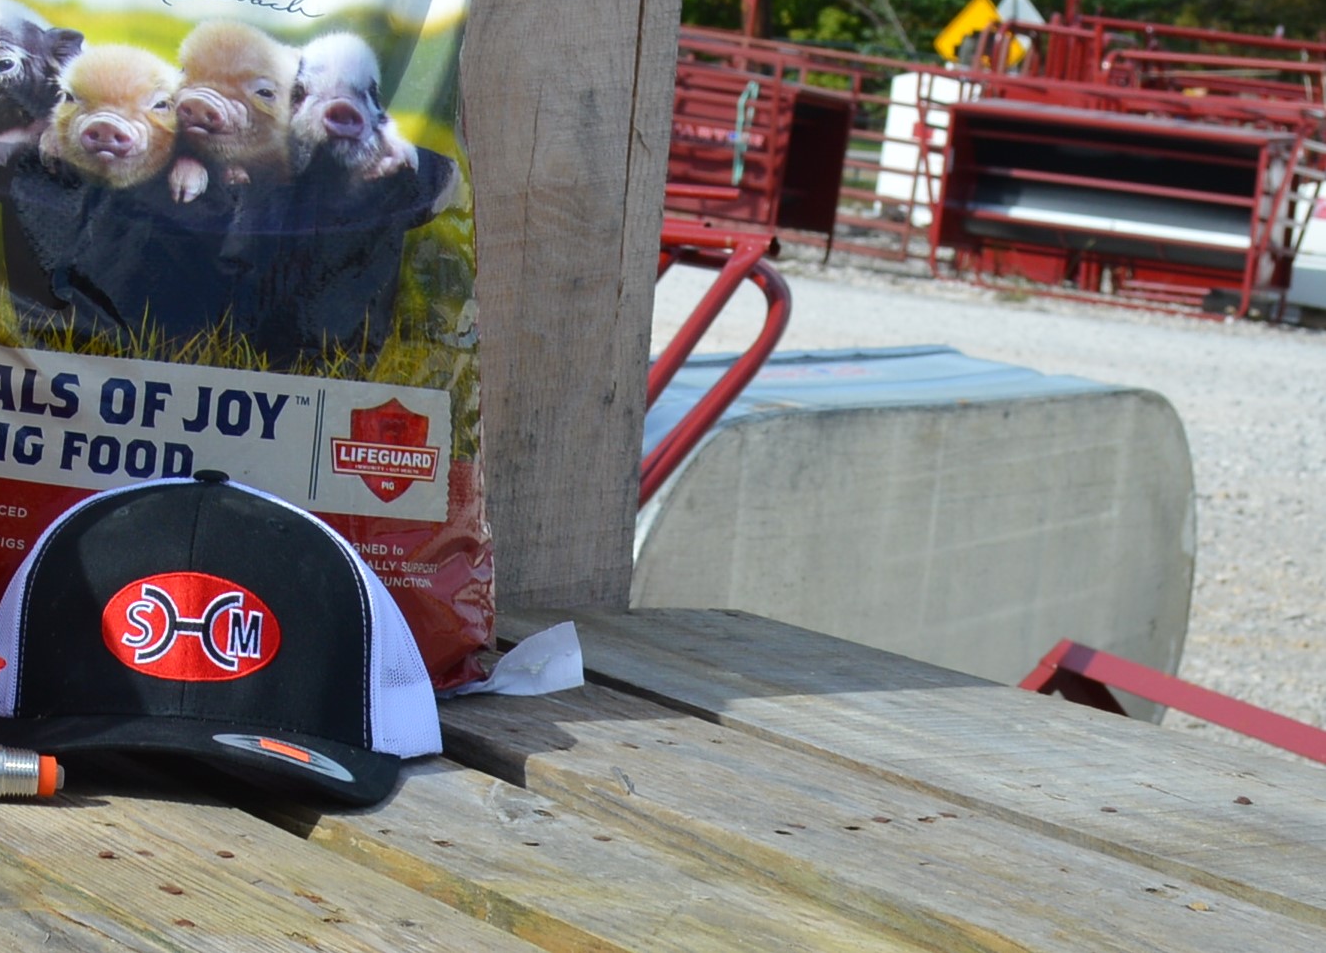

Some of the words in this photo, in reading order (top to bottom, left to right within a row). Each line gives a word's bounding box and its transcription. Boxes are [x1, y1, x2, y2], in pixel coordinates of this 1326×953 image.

[99, 377, 173, 428] OF
[181, 386, 290, 440] JOY
[59, 430, 194, 478] FOOD
[339, 445, 432, 468] LIFEGUARD
[381, 481, 395, 491] PIG
[392, 544, 404, 556] to
[401, 561, 438, 574] SUPPORT
